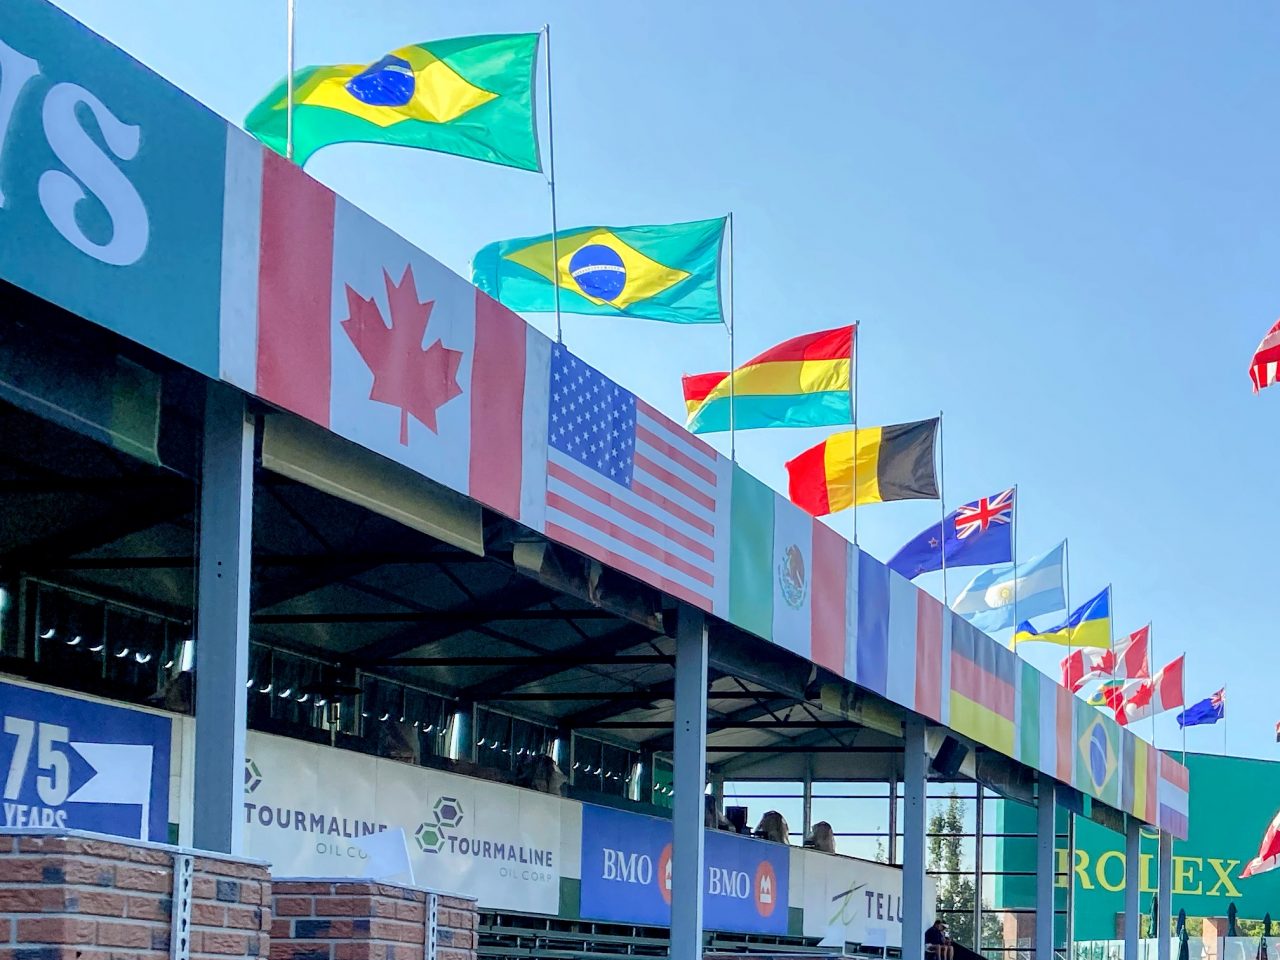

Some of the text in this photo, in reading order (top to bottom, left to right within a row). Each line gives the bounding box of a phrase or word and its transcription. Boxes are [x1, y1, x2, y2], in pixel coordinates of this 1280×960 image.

[3, 715, 70, 806] 75
[316, 842, 342, 857] OIL
[448, 836, 553, 868] TOURMALINE
[499, 866, 553, 882] OIL CORP
[602, 848, 652, 885] BMO
[1054, 848, 1243, 897] ROLEX
[708, 867, 750, 899] BMO
